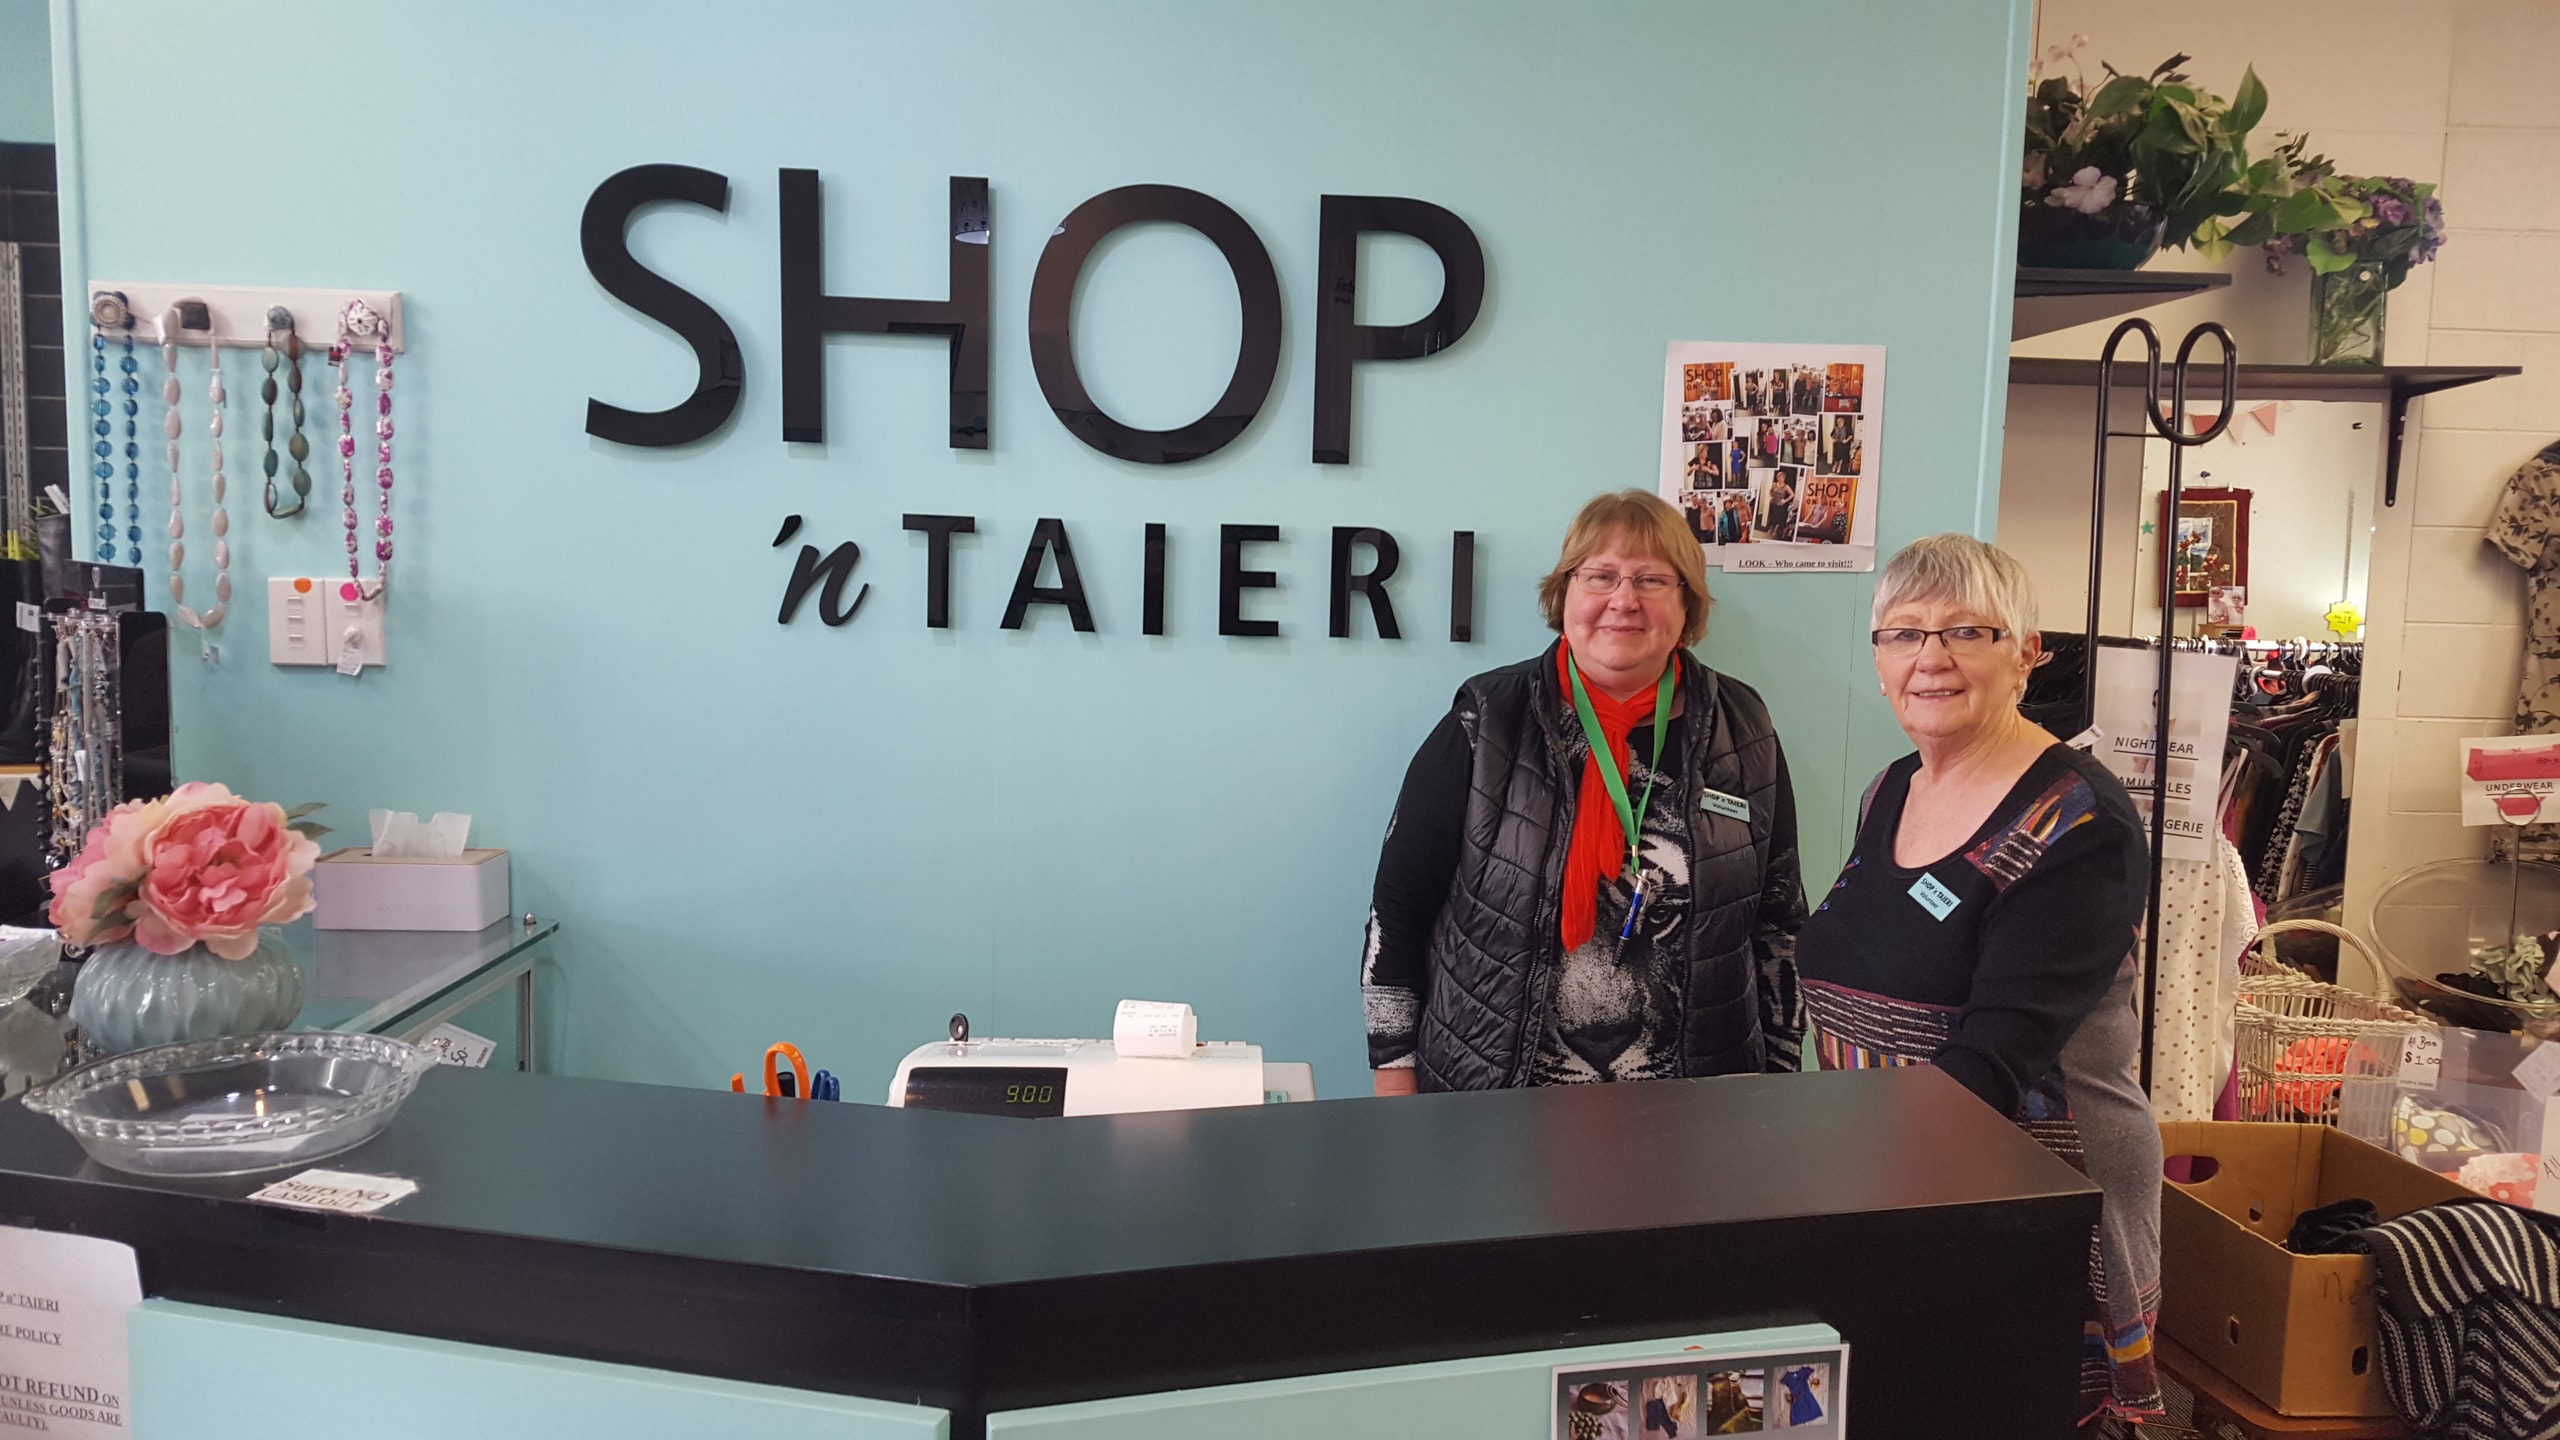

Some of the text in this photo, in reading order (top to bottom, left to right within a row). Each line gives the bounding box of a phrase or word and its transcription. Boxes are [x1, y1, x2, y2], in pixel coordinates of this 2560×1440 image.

[581, 163, 1486, 465] SHOP
[1686, 369, 1723, 383] SHOP
[1807, 482, 1849, 499] SHOP
[1739, 559, 1766, 569] LOOK
[1775, 559, 1793, 568] Who
[1795, 560, 1815, 568] came
[1818, 560, 1826, 568] to
[1827, 559, 1853, 569] visit!!!
[903, 513, 1475, 643] TAIERI
[2115, 736, 2194, 755] NIGHTEAR
[1712, 803, 1738, 814] Volunteer
[2143, 815, 2204, 834] LGERIE
[1920, 890, 1939, 909] Volunteer
[1921, 878, 1935, 890] SHOP
[1937, 891, 1953, 907] TAIERI
[346, 1188, 390, 1200] NO
[18, 1294, 60, 1312] TAIERI
[16, 1326, 62, 1345] POLICY
[26, 1378, 99, 1403] REFUND
[102, 1393, 120, 1407] ON
[49, 1404, 95, 1421] GOODS
[97, 1411, 122, 1427] ARE
